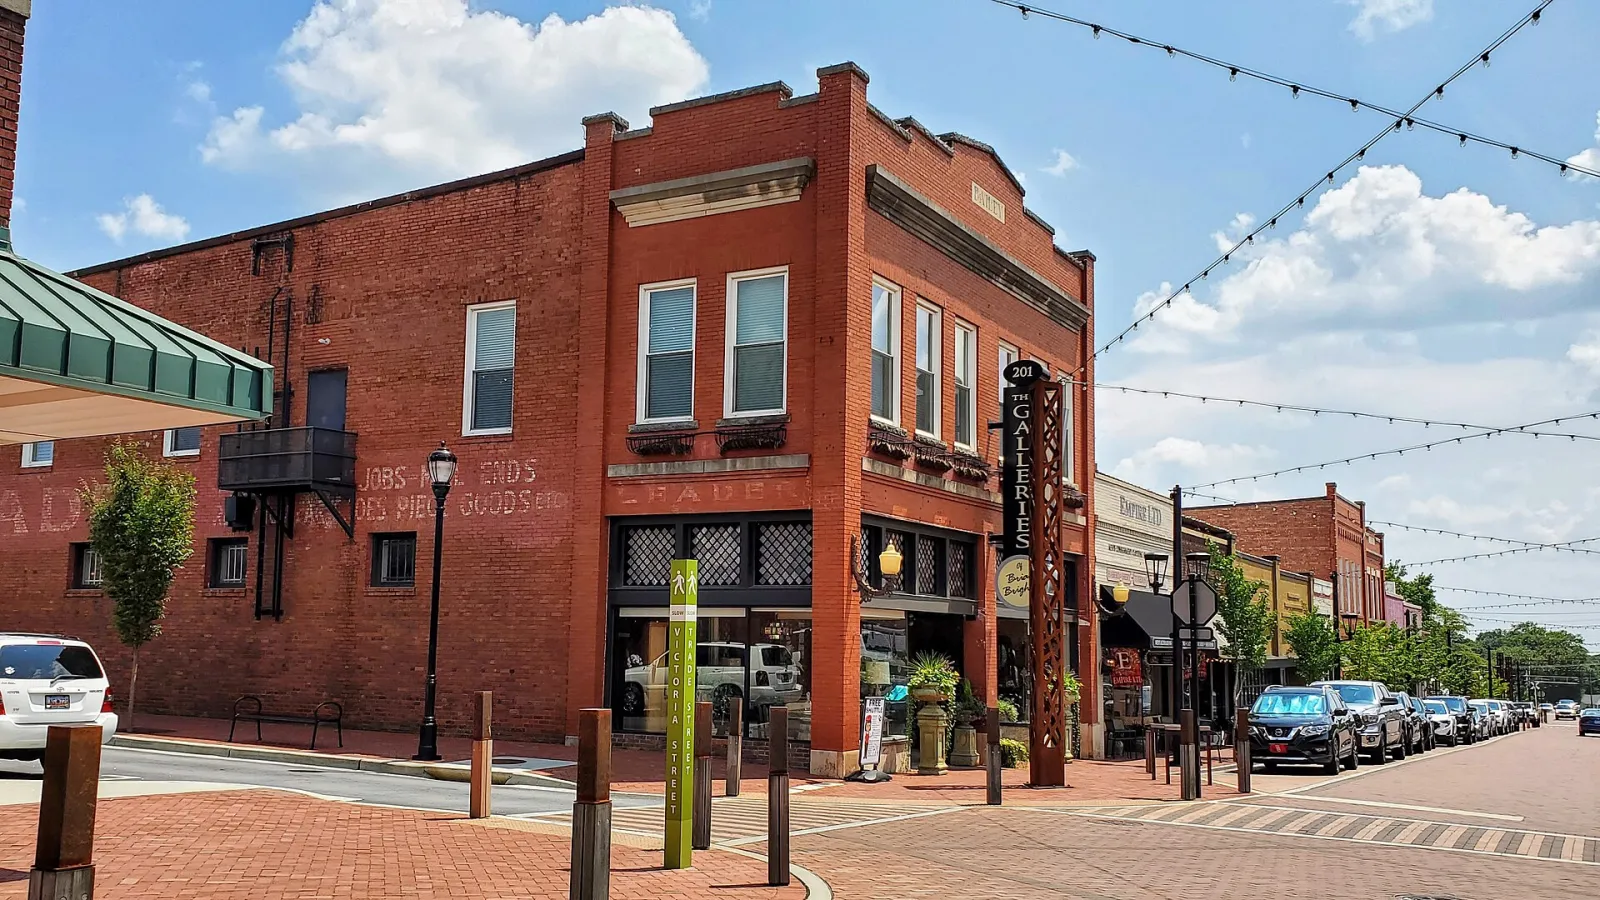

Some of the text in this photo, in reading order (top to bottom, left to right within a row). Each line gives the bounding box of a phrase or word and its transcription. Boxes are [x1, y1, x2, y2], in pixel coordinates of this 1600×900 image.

[1012, 366, 1033, 378] 201
[1011, 393, 1029, 401] TH
[480, 458, 538, 485] ENDS
[1013, 404, 1030, 549] GALLERIES
[397, 495, 447, 519] PIEC
[1005, 573, 1030, 584] Bria
[1003, 582, 1030, 597] Brigh
[670, 627, 681, 814] VICTORIA STREET
